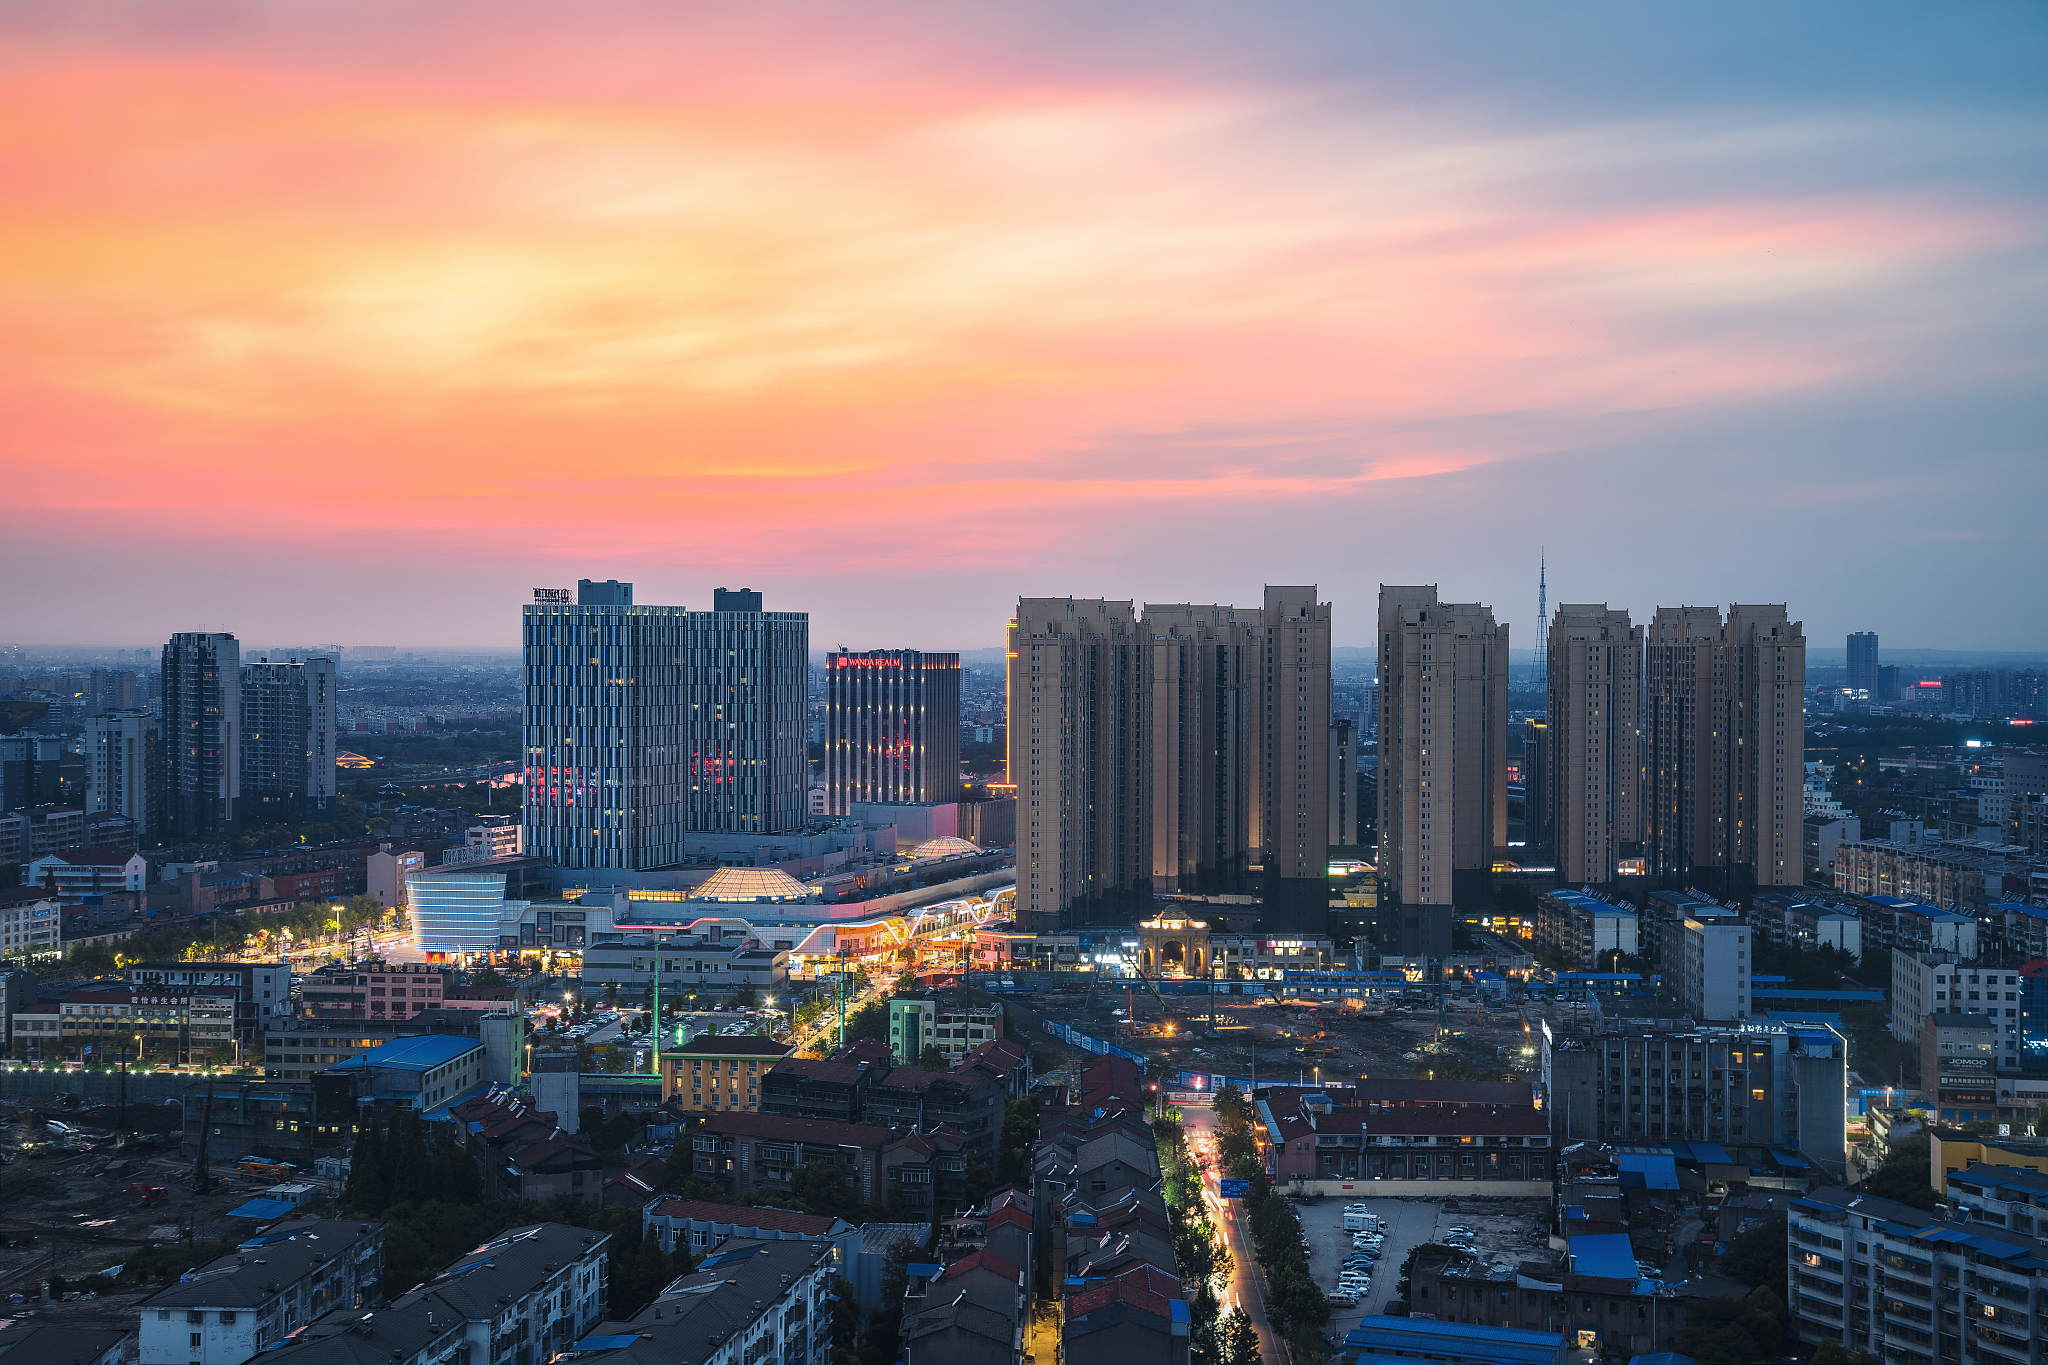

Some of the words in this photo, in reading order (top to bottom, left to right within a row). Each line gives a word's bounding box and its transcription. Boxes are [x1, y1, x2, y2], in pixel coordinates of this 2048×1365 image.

[849, 658, 874, 667] WANDA
[875, 658, 900, 667] REALM
[1949, 1058, 1987, 1066] JOMOO
